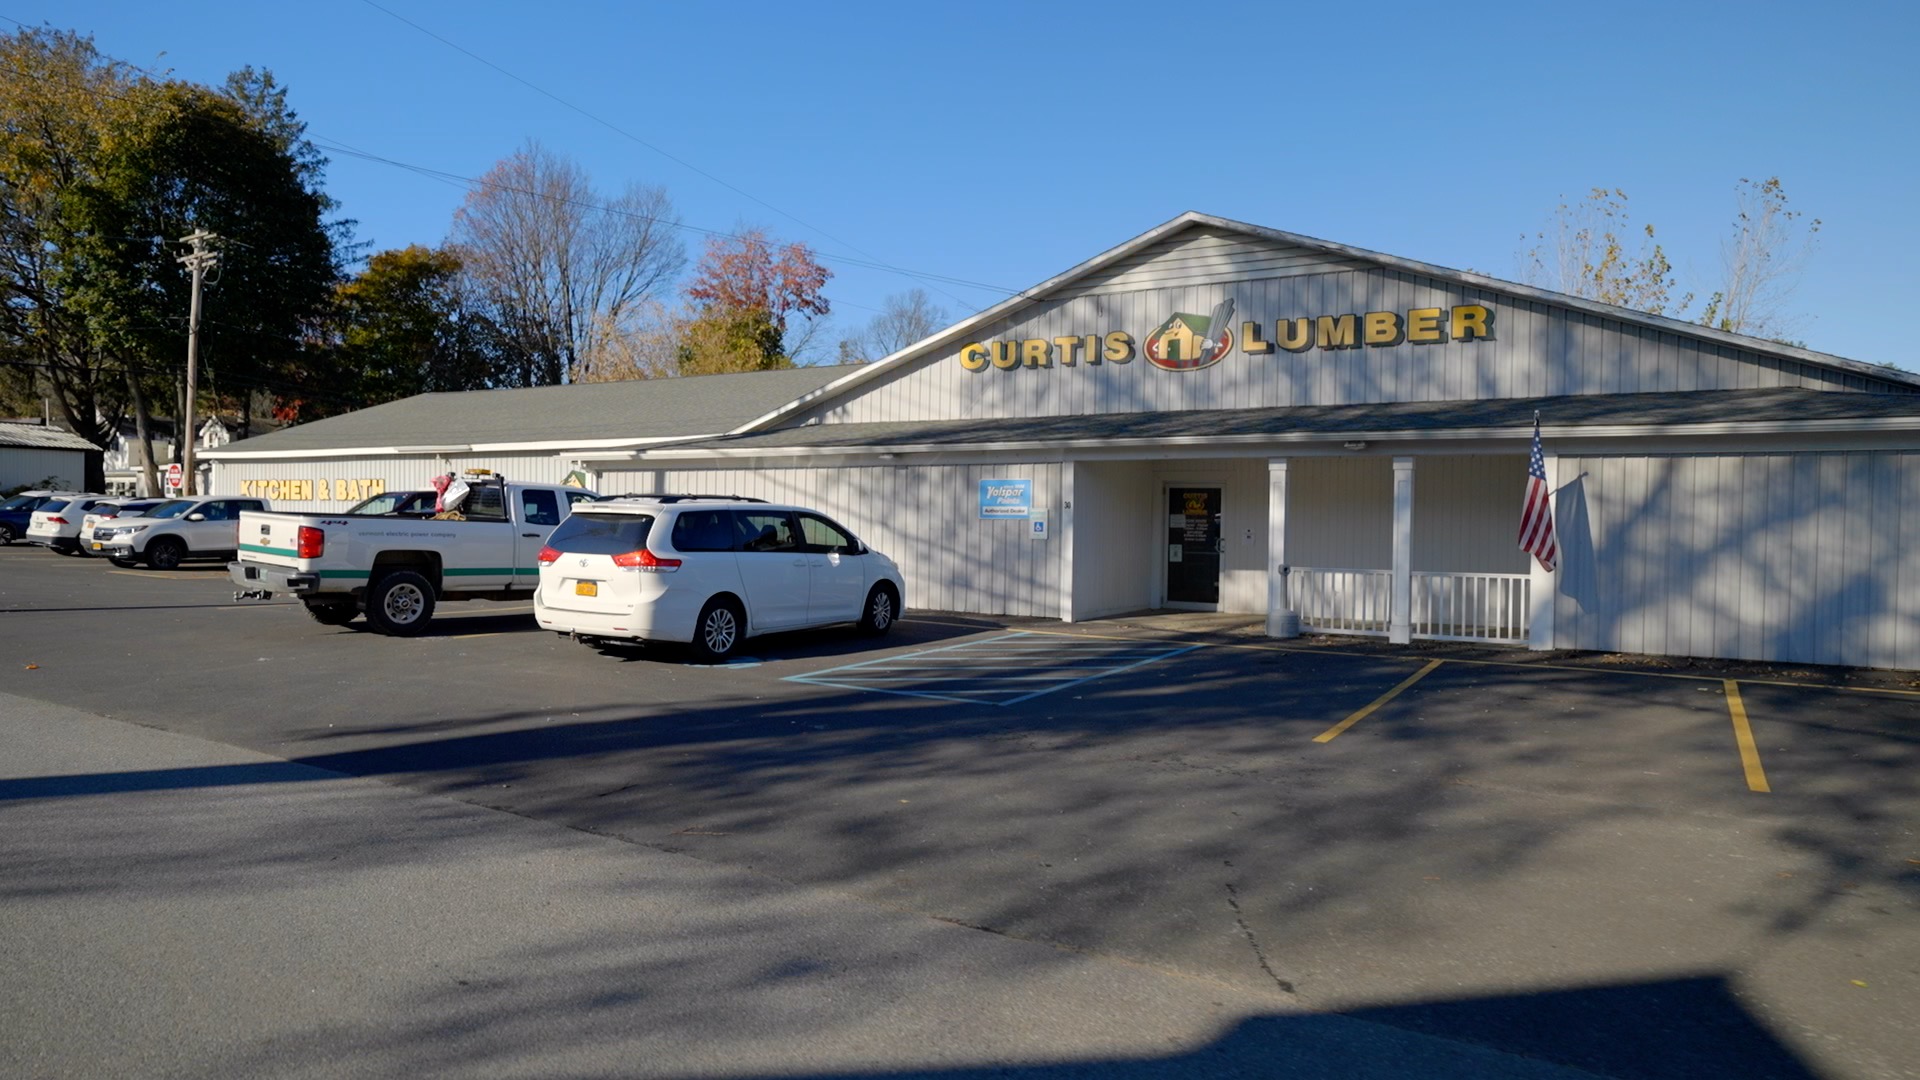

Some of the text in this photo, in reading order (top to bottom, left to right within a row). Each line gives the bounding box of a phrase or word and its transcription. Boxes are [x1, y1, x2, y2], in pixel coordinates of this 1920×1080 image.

[959, 305, 1496, 373] CURTIS LUMBER
[239, 478, 385, 500] KITCHEN & BATH
[986, 486, 1024, 499] Valspar
[386, 529, 409, 537] electric
[430, 531, 456, 539] company
